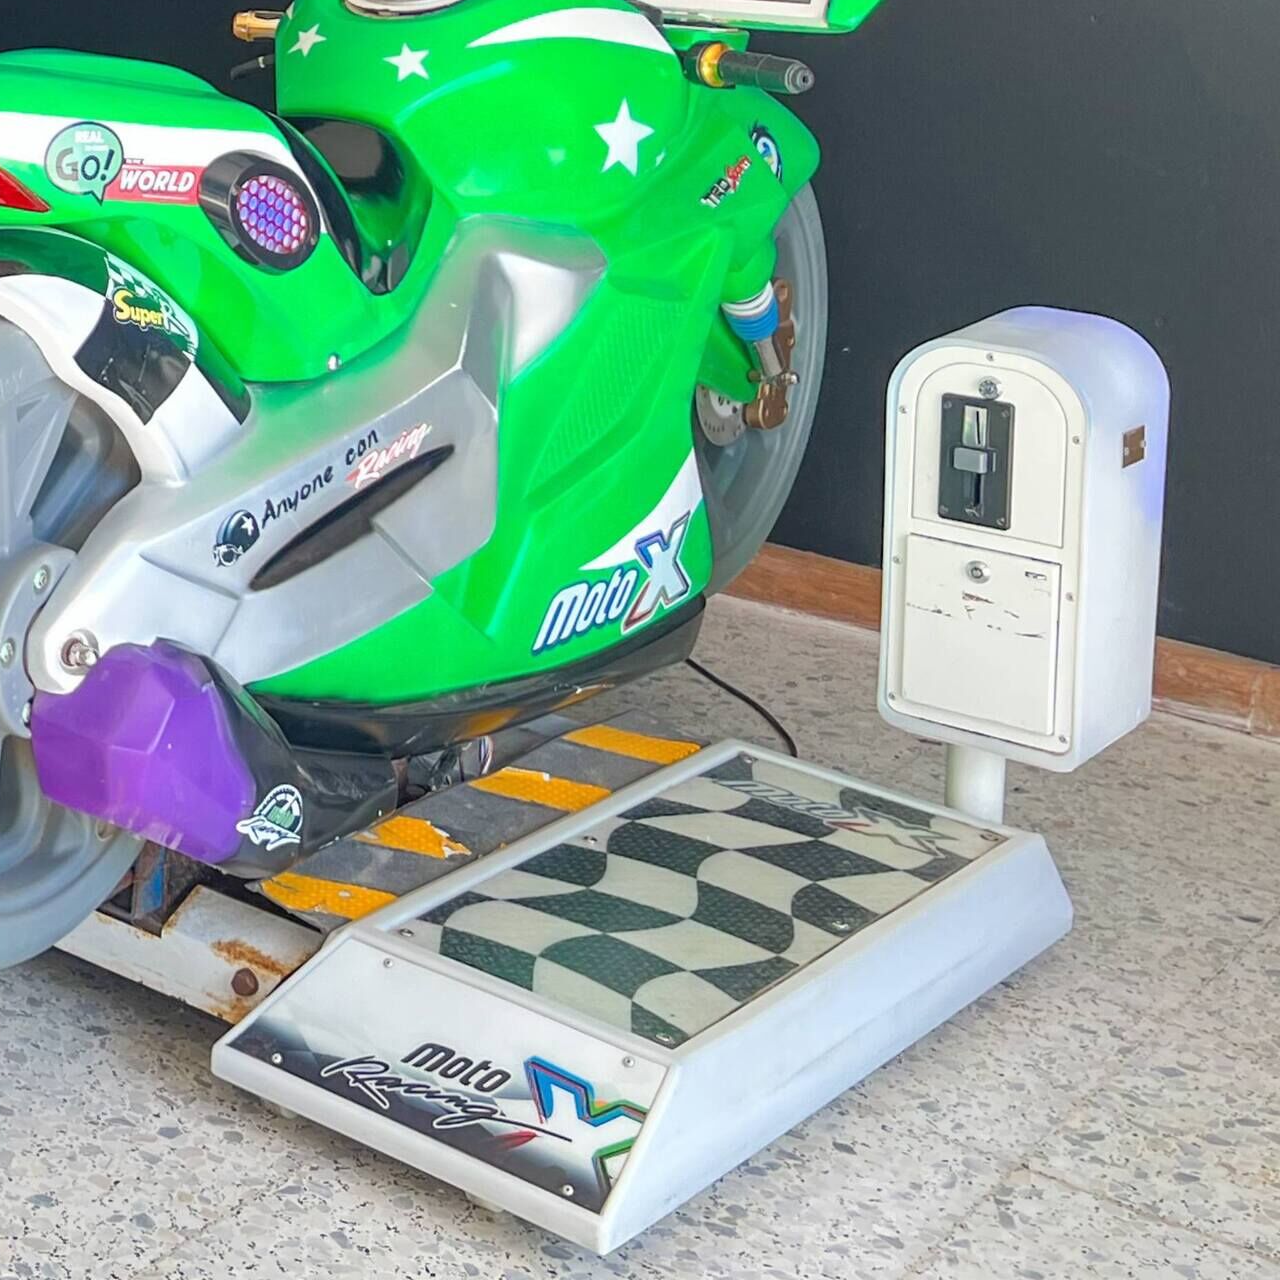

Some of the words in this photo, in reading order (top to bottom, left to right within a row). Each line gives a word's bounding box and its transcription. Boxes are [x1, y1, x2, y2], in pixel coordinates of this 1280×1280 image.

[119, 169, 196, 193] WORLD
[260, 465, 335, 530] Anyone
[345, 428, 379, 467] can
[350, 423, 433, 489] Racing
[320, 1055, 574, 1143] Racing
